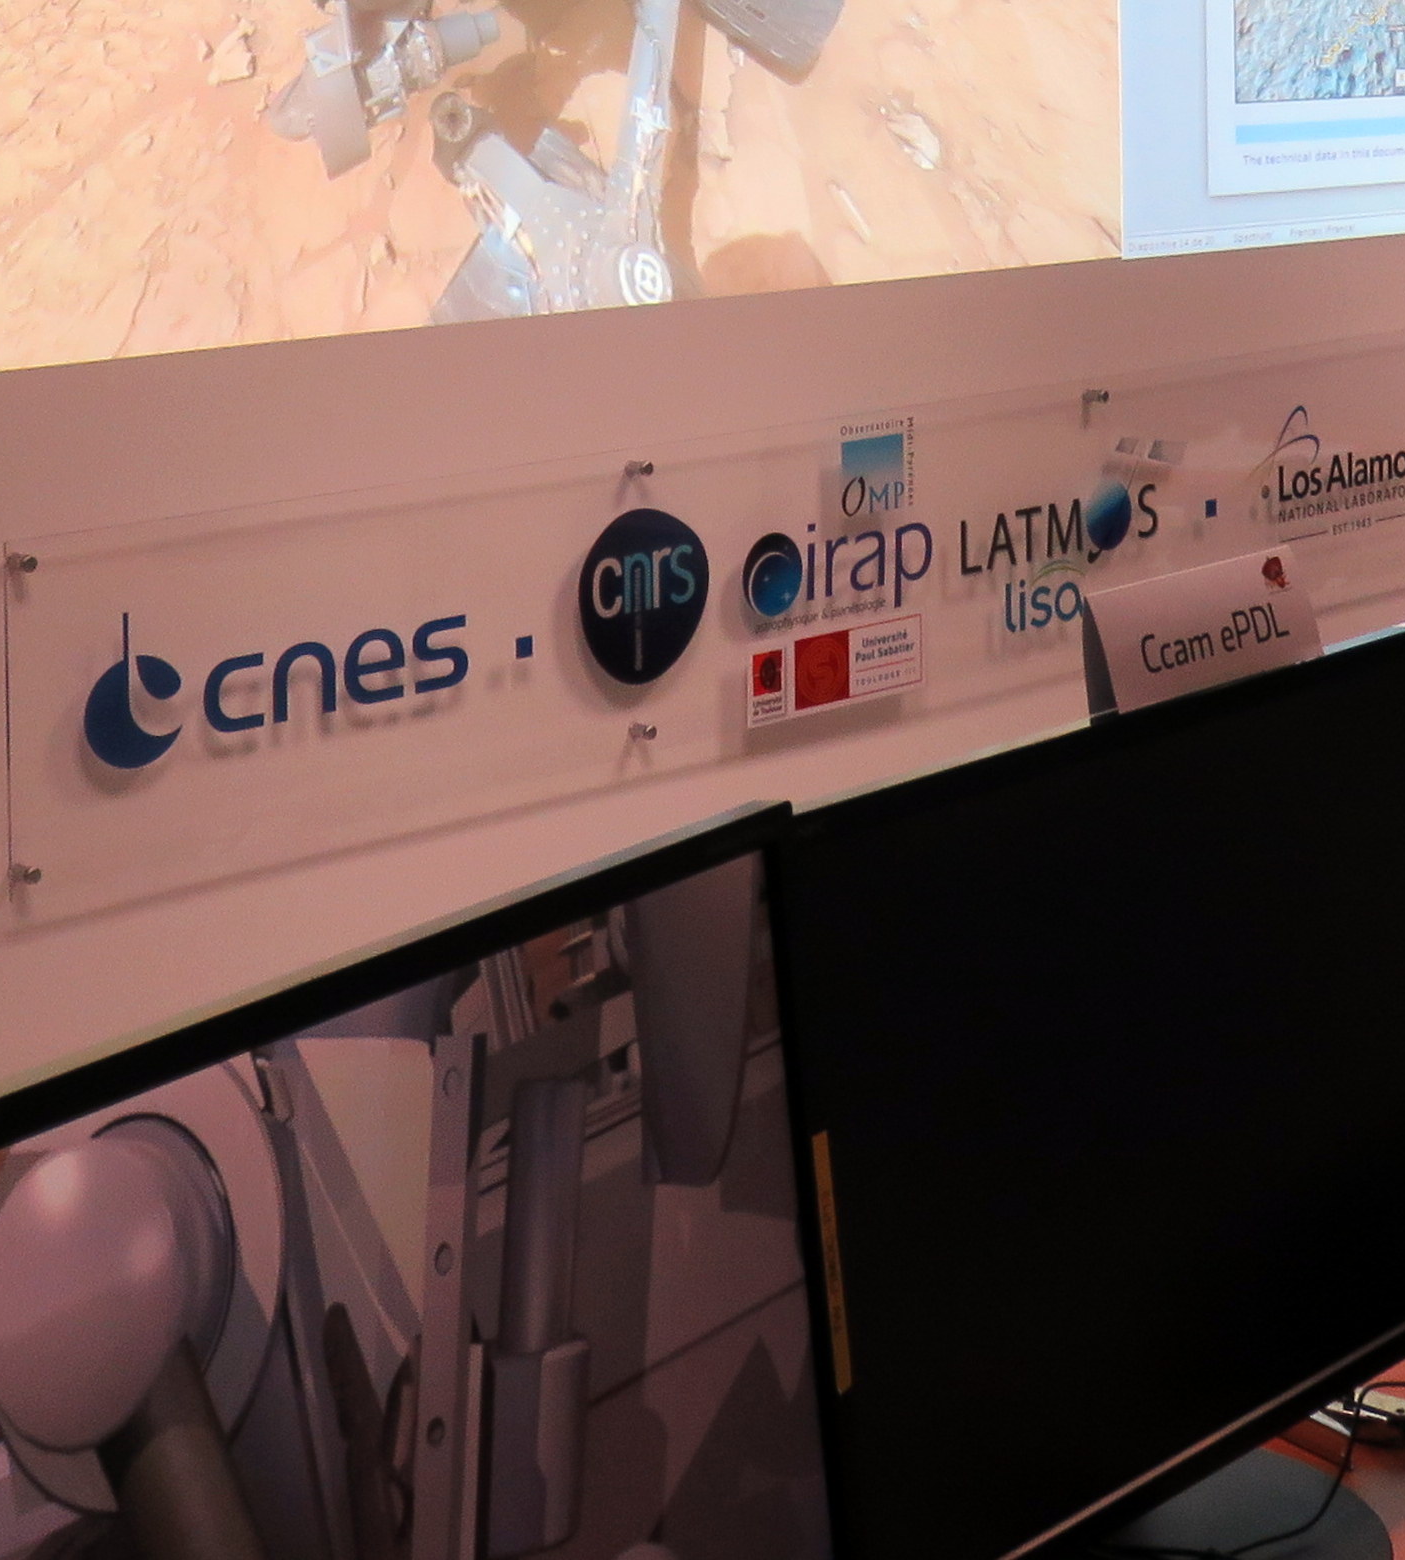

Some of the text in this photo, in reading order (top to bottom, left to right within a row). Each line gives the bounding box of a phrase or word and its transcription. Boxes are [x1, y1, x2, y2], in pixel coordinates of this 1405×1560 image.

[1314, 149, 1337, 161] data
[840, 419, 904, 436] Observatoire
[842, 476, 905, 517] OMP
[1277, 462, 1322, 502] Los
[1277, 498, 1341, 524] NATIONAL
[592, 543, 695, 619] cnrs
[805, 522, 933, 609] irap
[753, 604, 819, 635] astrophysique
[1003, 580, 1084, 634] lisa
[855, 640, 915, 663] Paul Sabatier
[861, 630, 908, 648] Université
[1141, 602, 1291, 674] Ccam ePDL
[203, 614, 470, 733] cnes
[752, 695, 783, 709] Université
[761, 704, 783, 715] Toulouse
